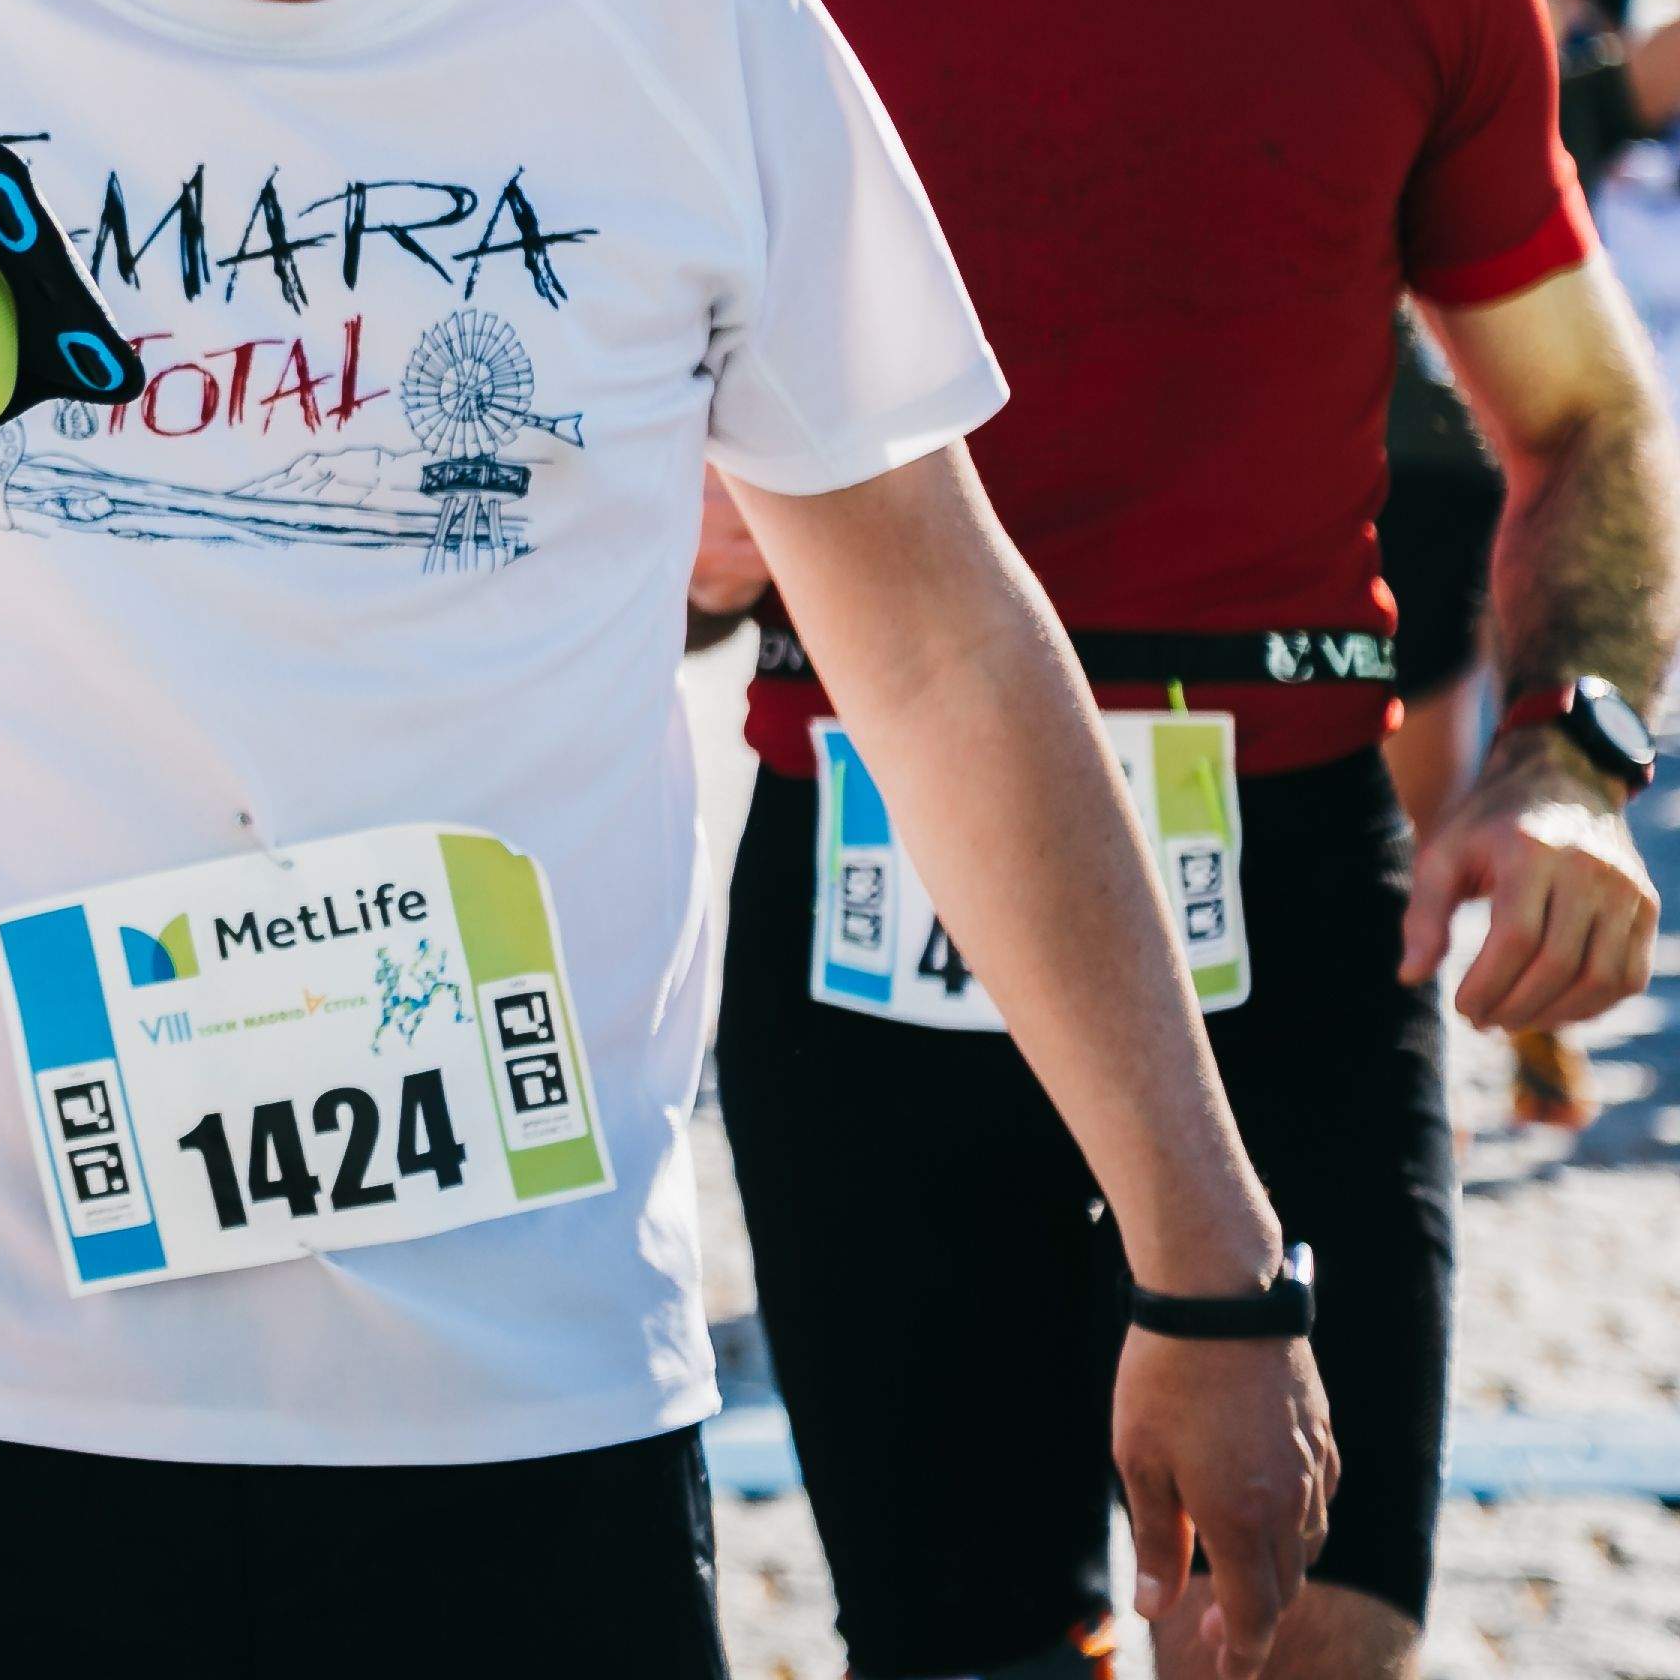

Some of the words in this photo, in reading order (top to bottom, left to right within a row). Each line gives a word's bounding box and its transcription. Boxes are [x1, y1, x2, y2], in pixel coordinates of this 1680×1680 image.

[68, 162, 602, 314] MARA
[1319, 632, 1397, 682] VEL
[213, 881, 428, 961] MetLife
[918, 913, 974, 996] 4
[178, 1066, 468, 1231] 1424
